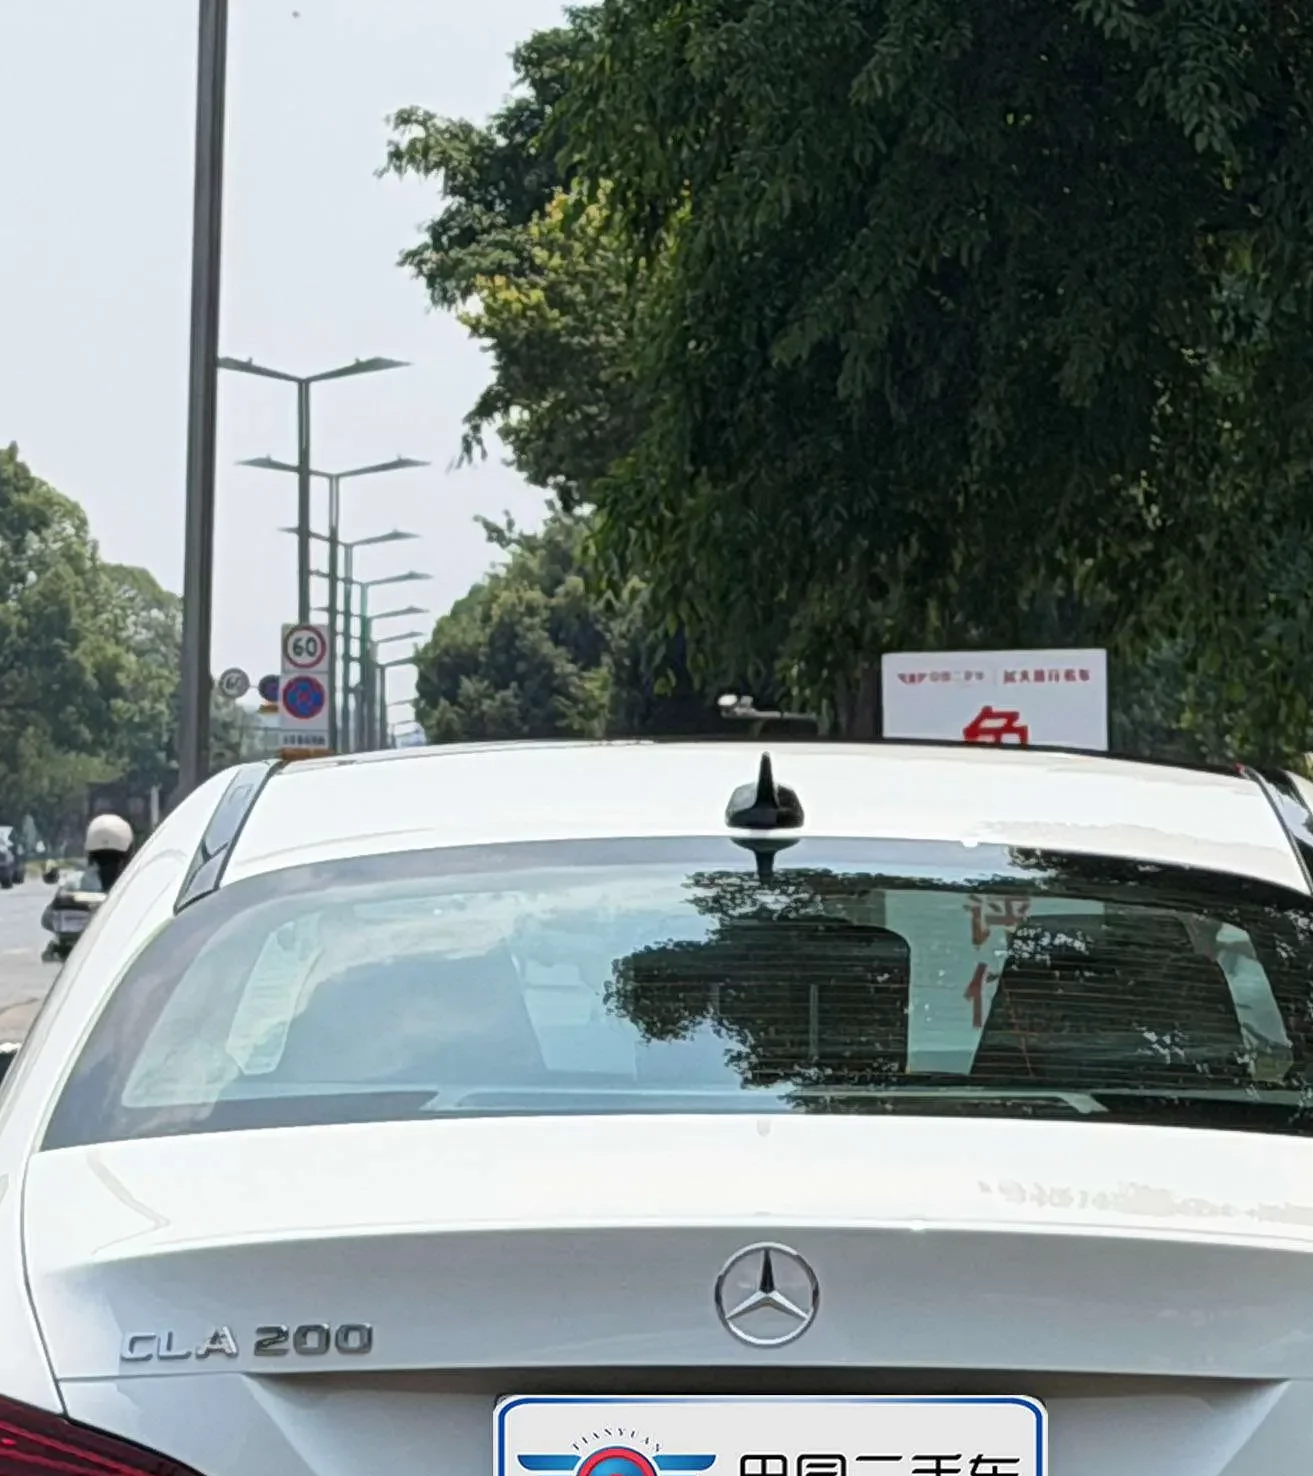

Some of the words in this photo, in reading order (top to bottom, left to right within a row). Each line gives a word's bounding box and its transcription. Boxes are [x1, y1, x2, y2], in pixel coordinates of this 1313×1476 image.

[293, 637, 317, 657] 60
[120, 1326, 239, 1362] CLA
[254, 1323, 373, 1356] 200
